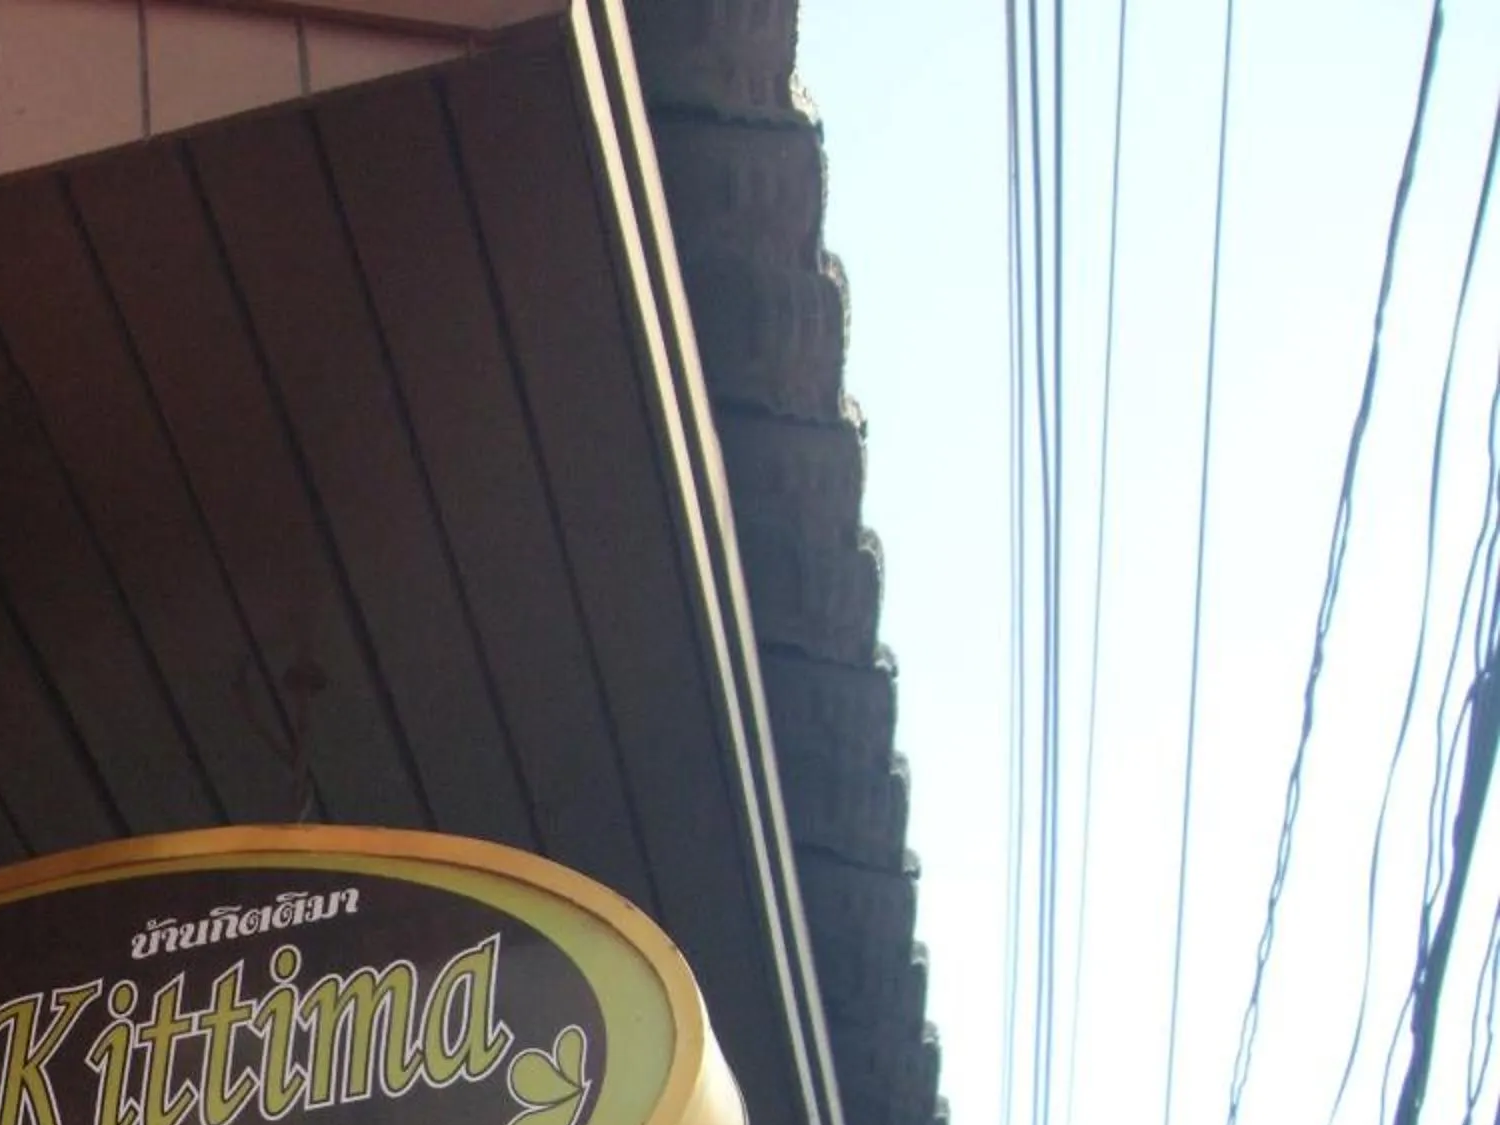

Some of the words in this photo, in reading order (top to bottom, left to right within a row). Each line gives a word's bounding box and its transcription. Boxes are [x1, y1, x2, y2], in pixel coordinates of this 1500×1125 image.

[131, 888, 359, 960] บ้านกิตติมา
